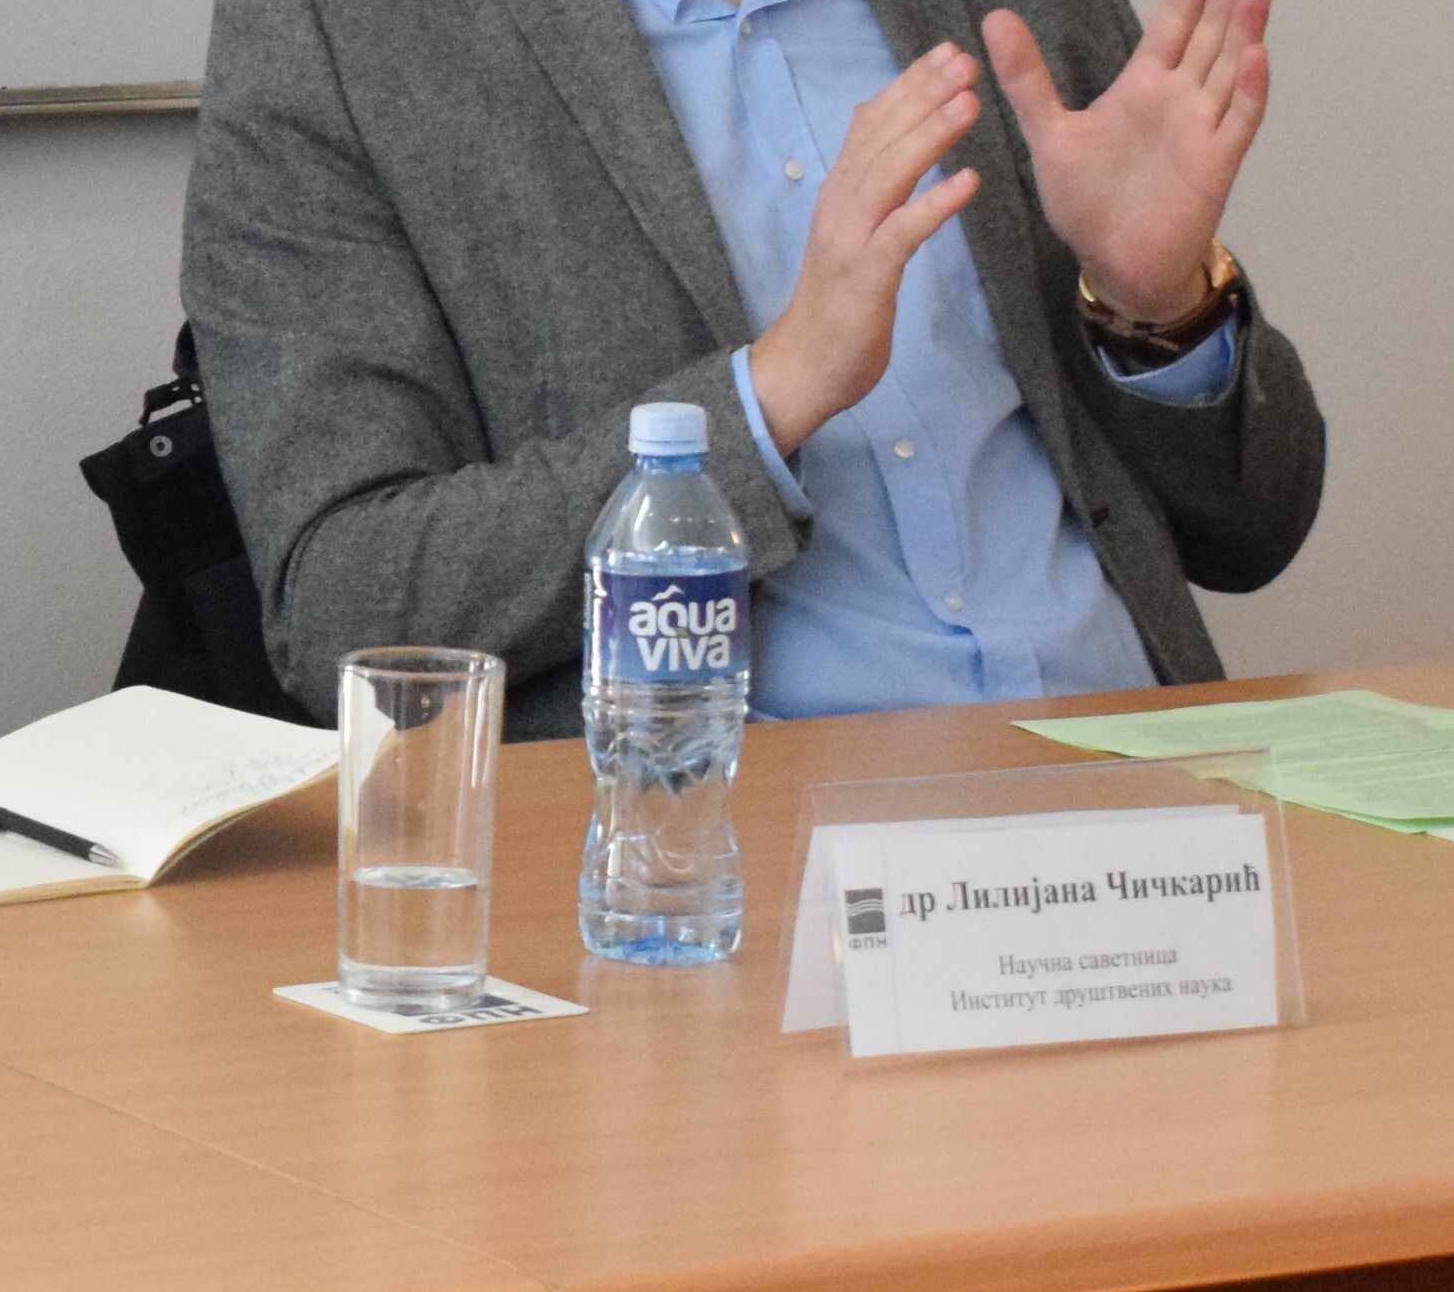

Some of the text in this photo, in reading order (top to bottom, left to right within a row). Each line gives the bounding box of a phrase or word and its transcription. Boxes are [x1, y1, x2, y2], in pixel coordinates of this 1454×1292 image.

[629, 598, 736, 637] aqua
[637, 634, 730, 672] viva
[900, 864, 1261, 921] др Лилијана Чичкарић
[848, 936, 887, 950] ФПН
[999, 949, 1178, 979] Научна саветница
[951, 976, 1233, 1011] Институт друштвених наука
[419, 1006, 543, 1024] ФПН
